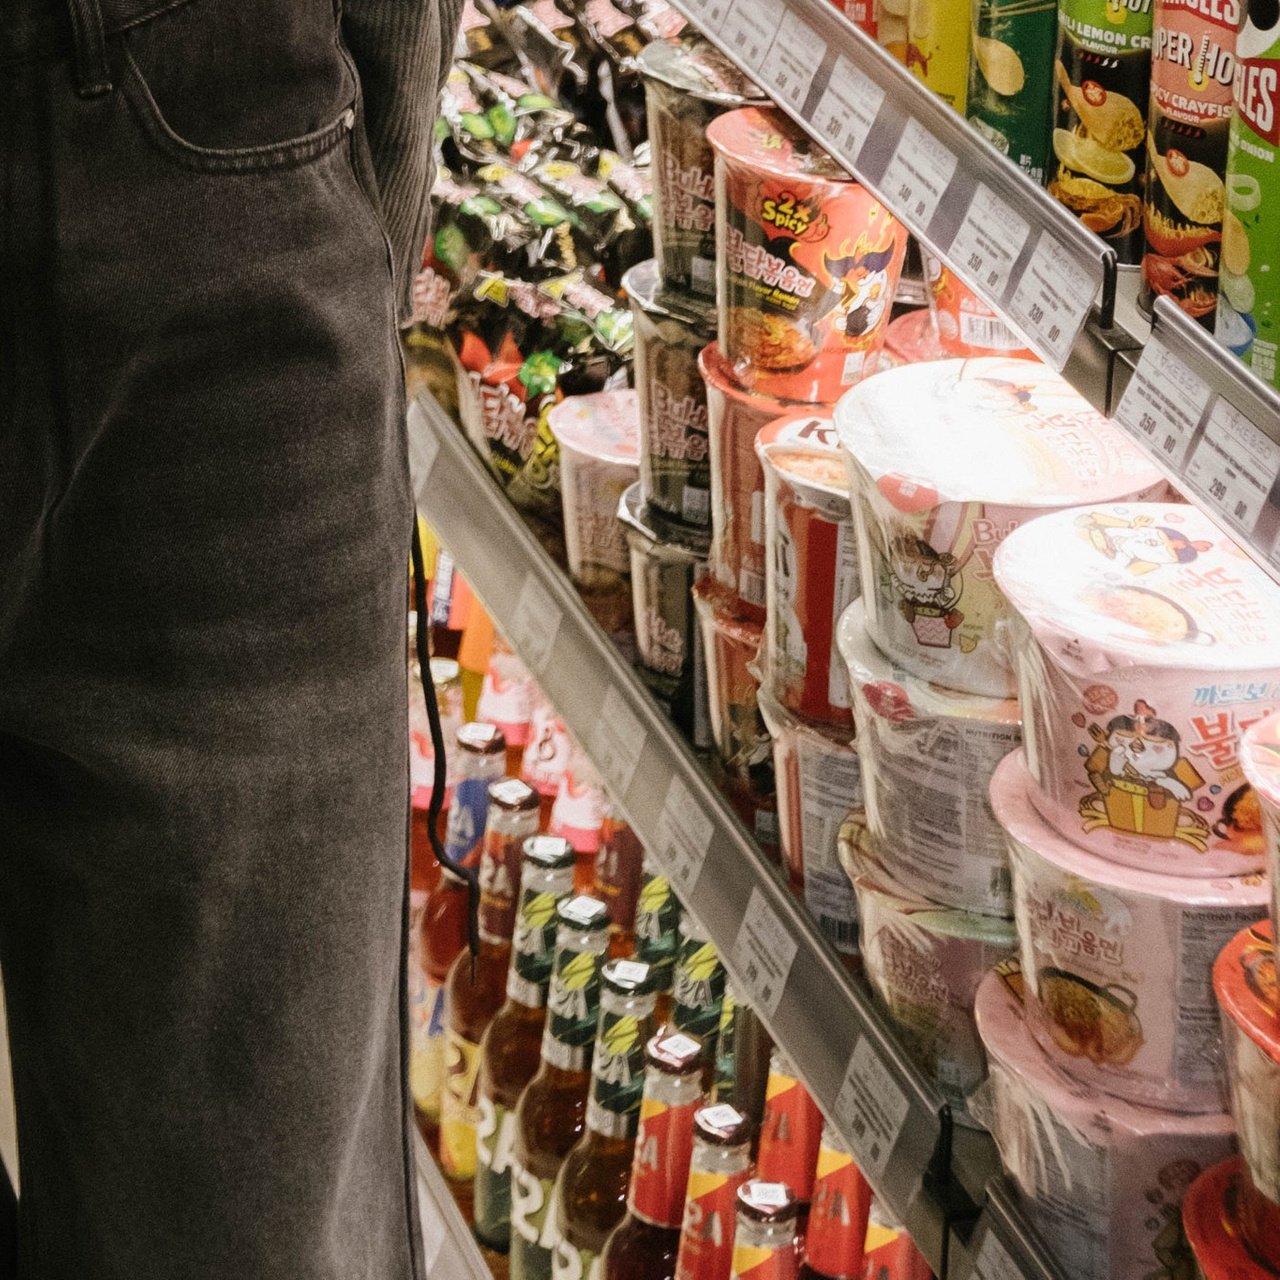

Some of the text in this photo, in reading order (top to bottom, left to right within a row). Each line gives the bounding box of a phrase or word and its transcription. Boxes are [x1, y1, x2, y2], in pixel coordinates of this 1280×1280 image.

[1077, 22, 1127, 47] LEMON
[1130, 34, 1152, 49] CR
[1082, 38, 1118, 55] FLAVOUR
[1194, 34, 1235, 86] HO
[1167, 107, 1201, 124] FLAVOUR
[1172, 94, 1233, 119] CRAYFIS
[762, 200, 808, 236] Spicy
[1047, 325, 1061, 342] 00
[1138, 411, 1176, 454] 350 00
[1208, 477, 1248, 520] 299 00
[1194, 681, 1268, 708] 까르보
